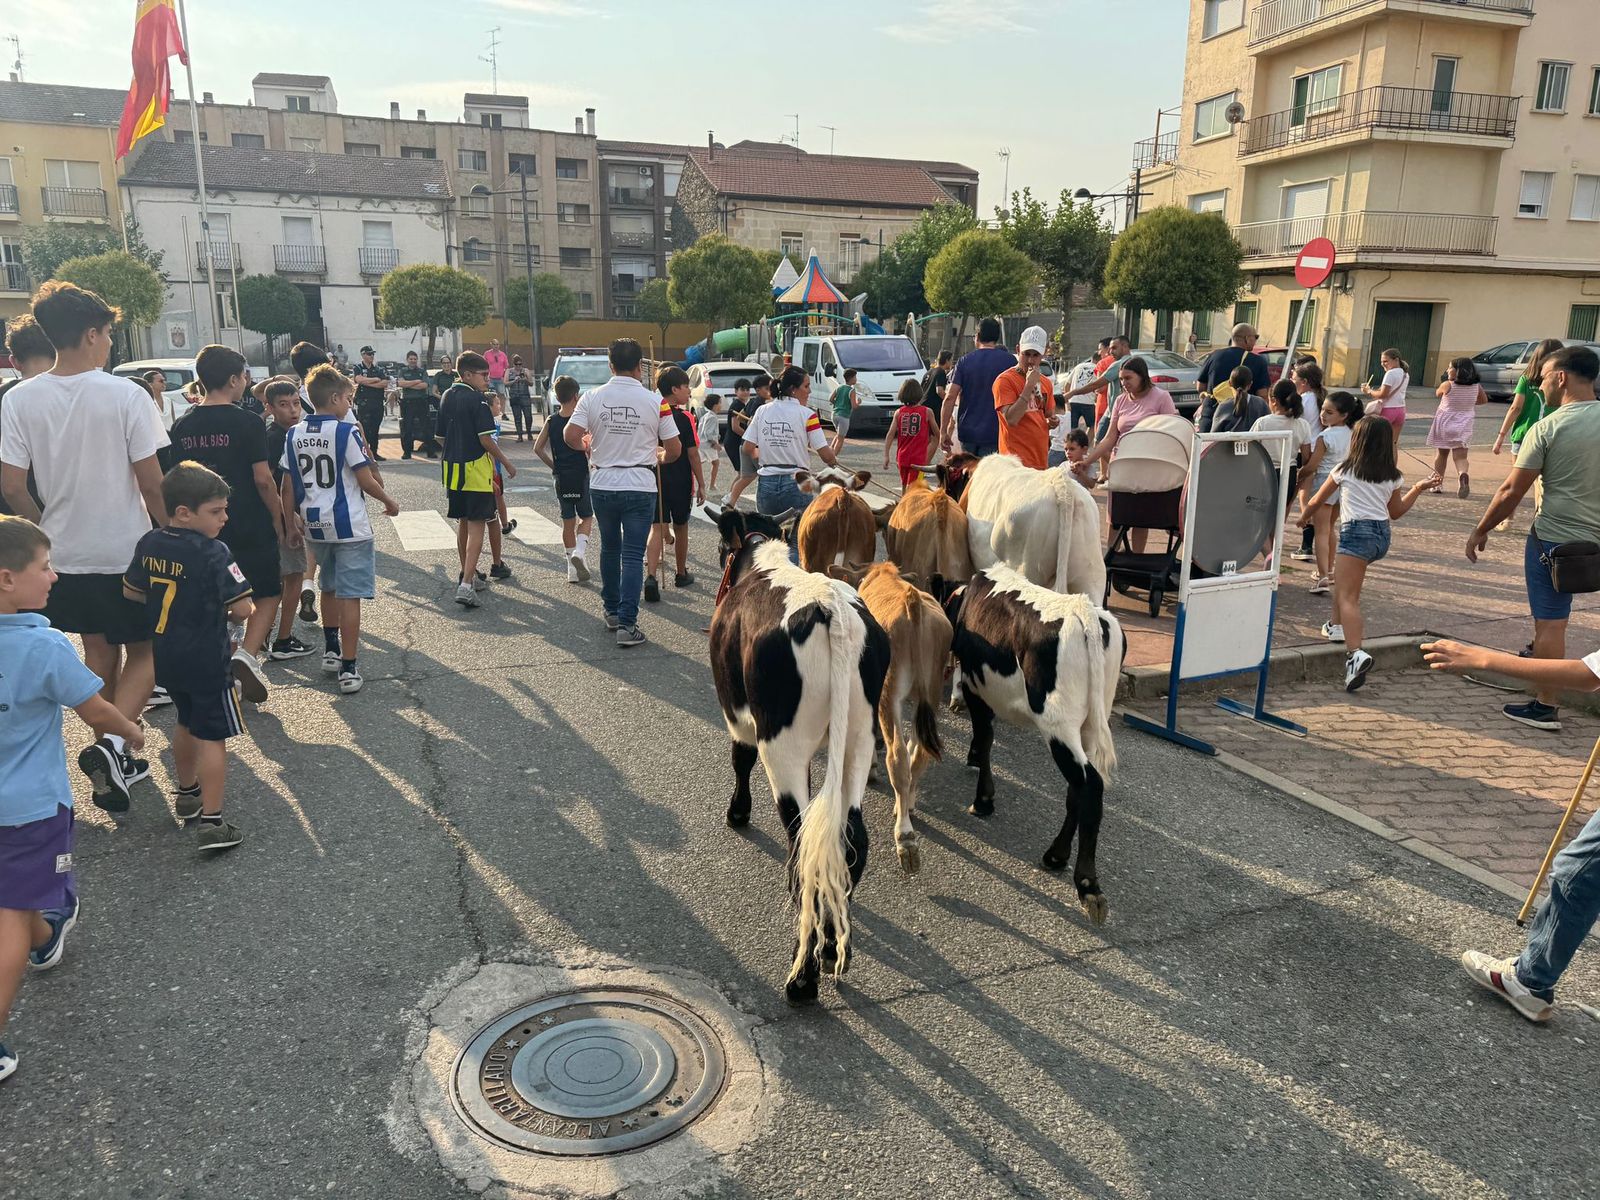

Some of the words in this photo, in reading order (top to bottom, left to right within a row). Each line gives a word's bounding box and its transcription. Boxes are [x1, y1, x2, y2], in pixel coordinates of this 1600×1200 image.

[296, 438, 329, 449] ÓSCAR
[298, 453, 336, 489] 20
[142, 556, 167, 574] VINI
[170, 561, 187, 579] JR.
[150, 575, 177, 635] 7
[483, 1051, 610, 1138] ALCANTARILLADO
